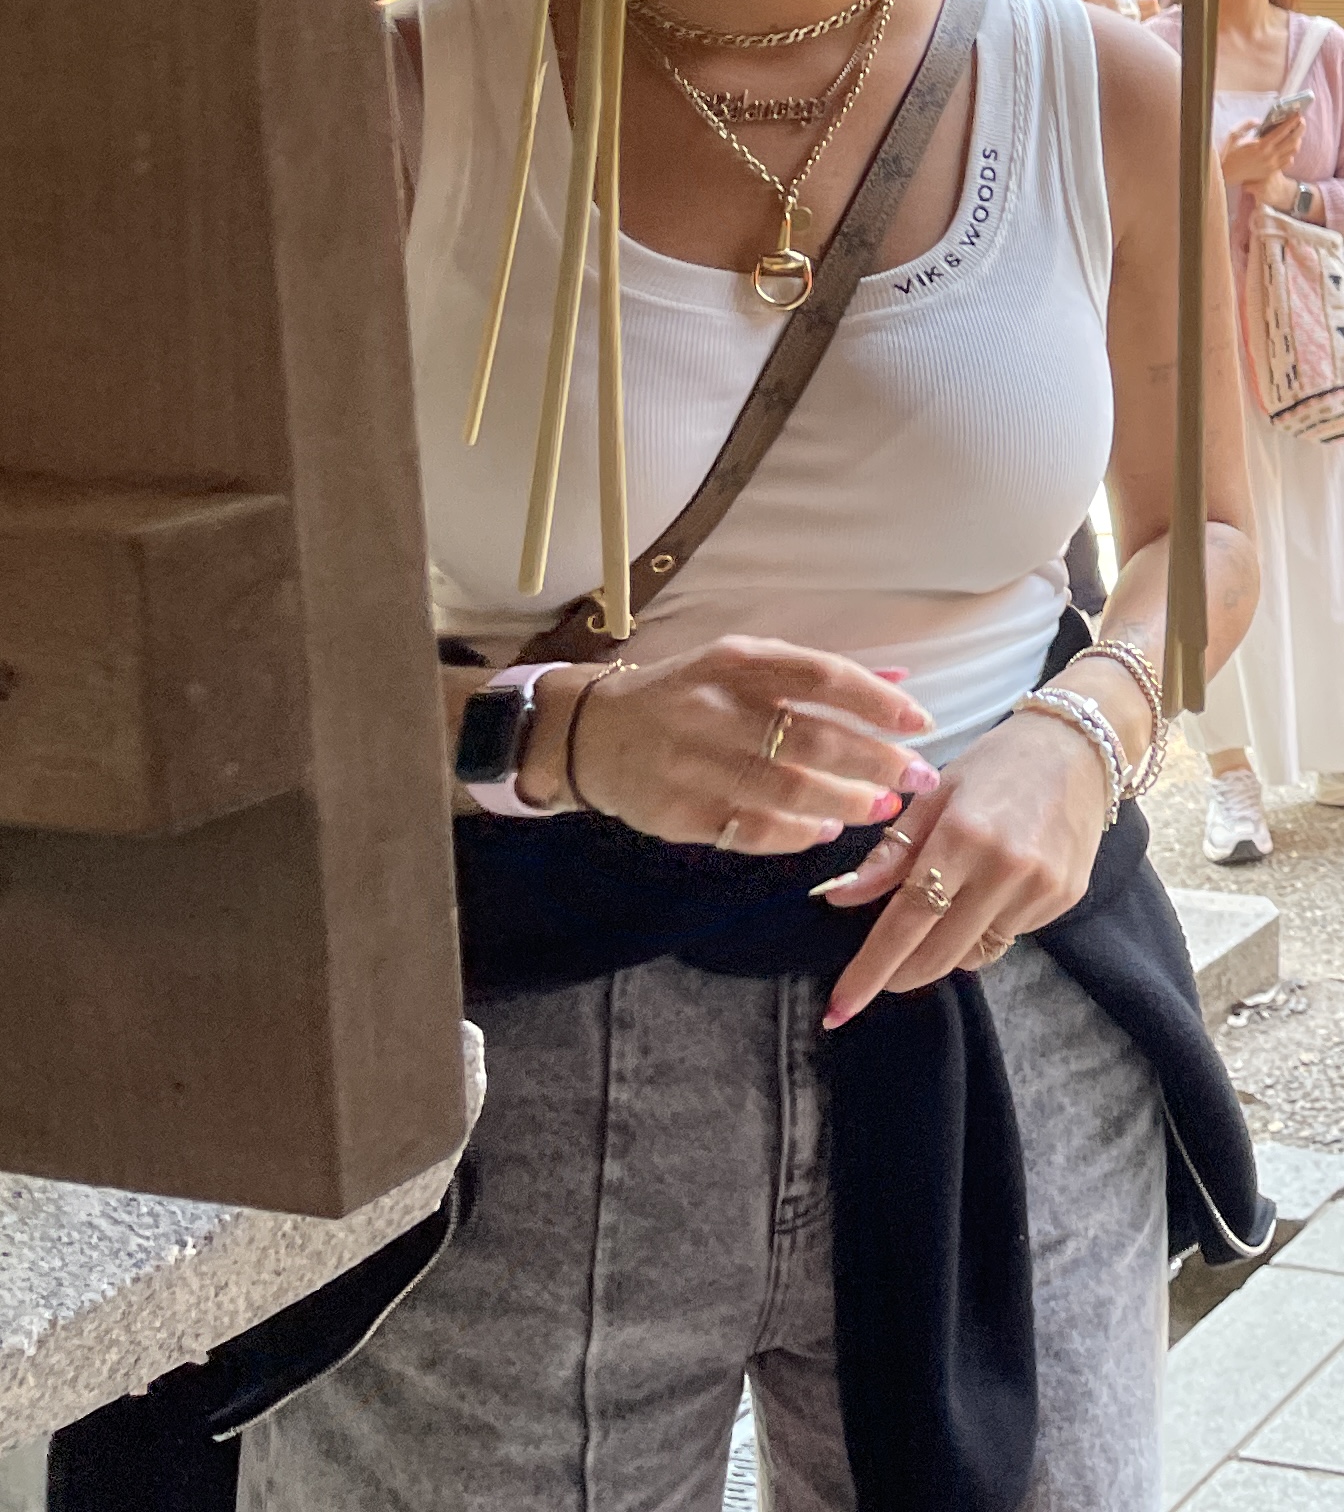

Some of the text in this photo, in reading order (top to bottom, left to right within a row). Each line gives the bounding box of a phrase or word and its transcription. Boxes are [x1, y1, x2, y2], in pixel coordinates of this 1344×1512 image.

[894, 147, 998, 294] VIK & WOODS
